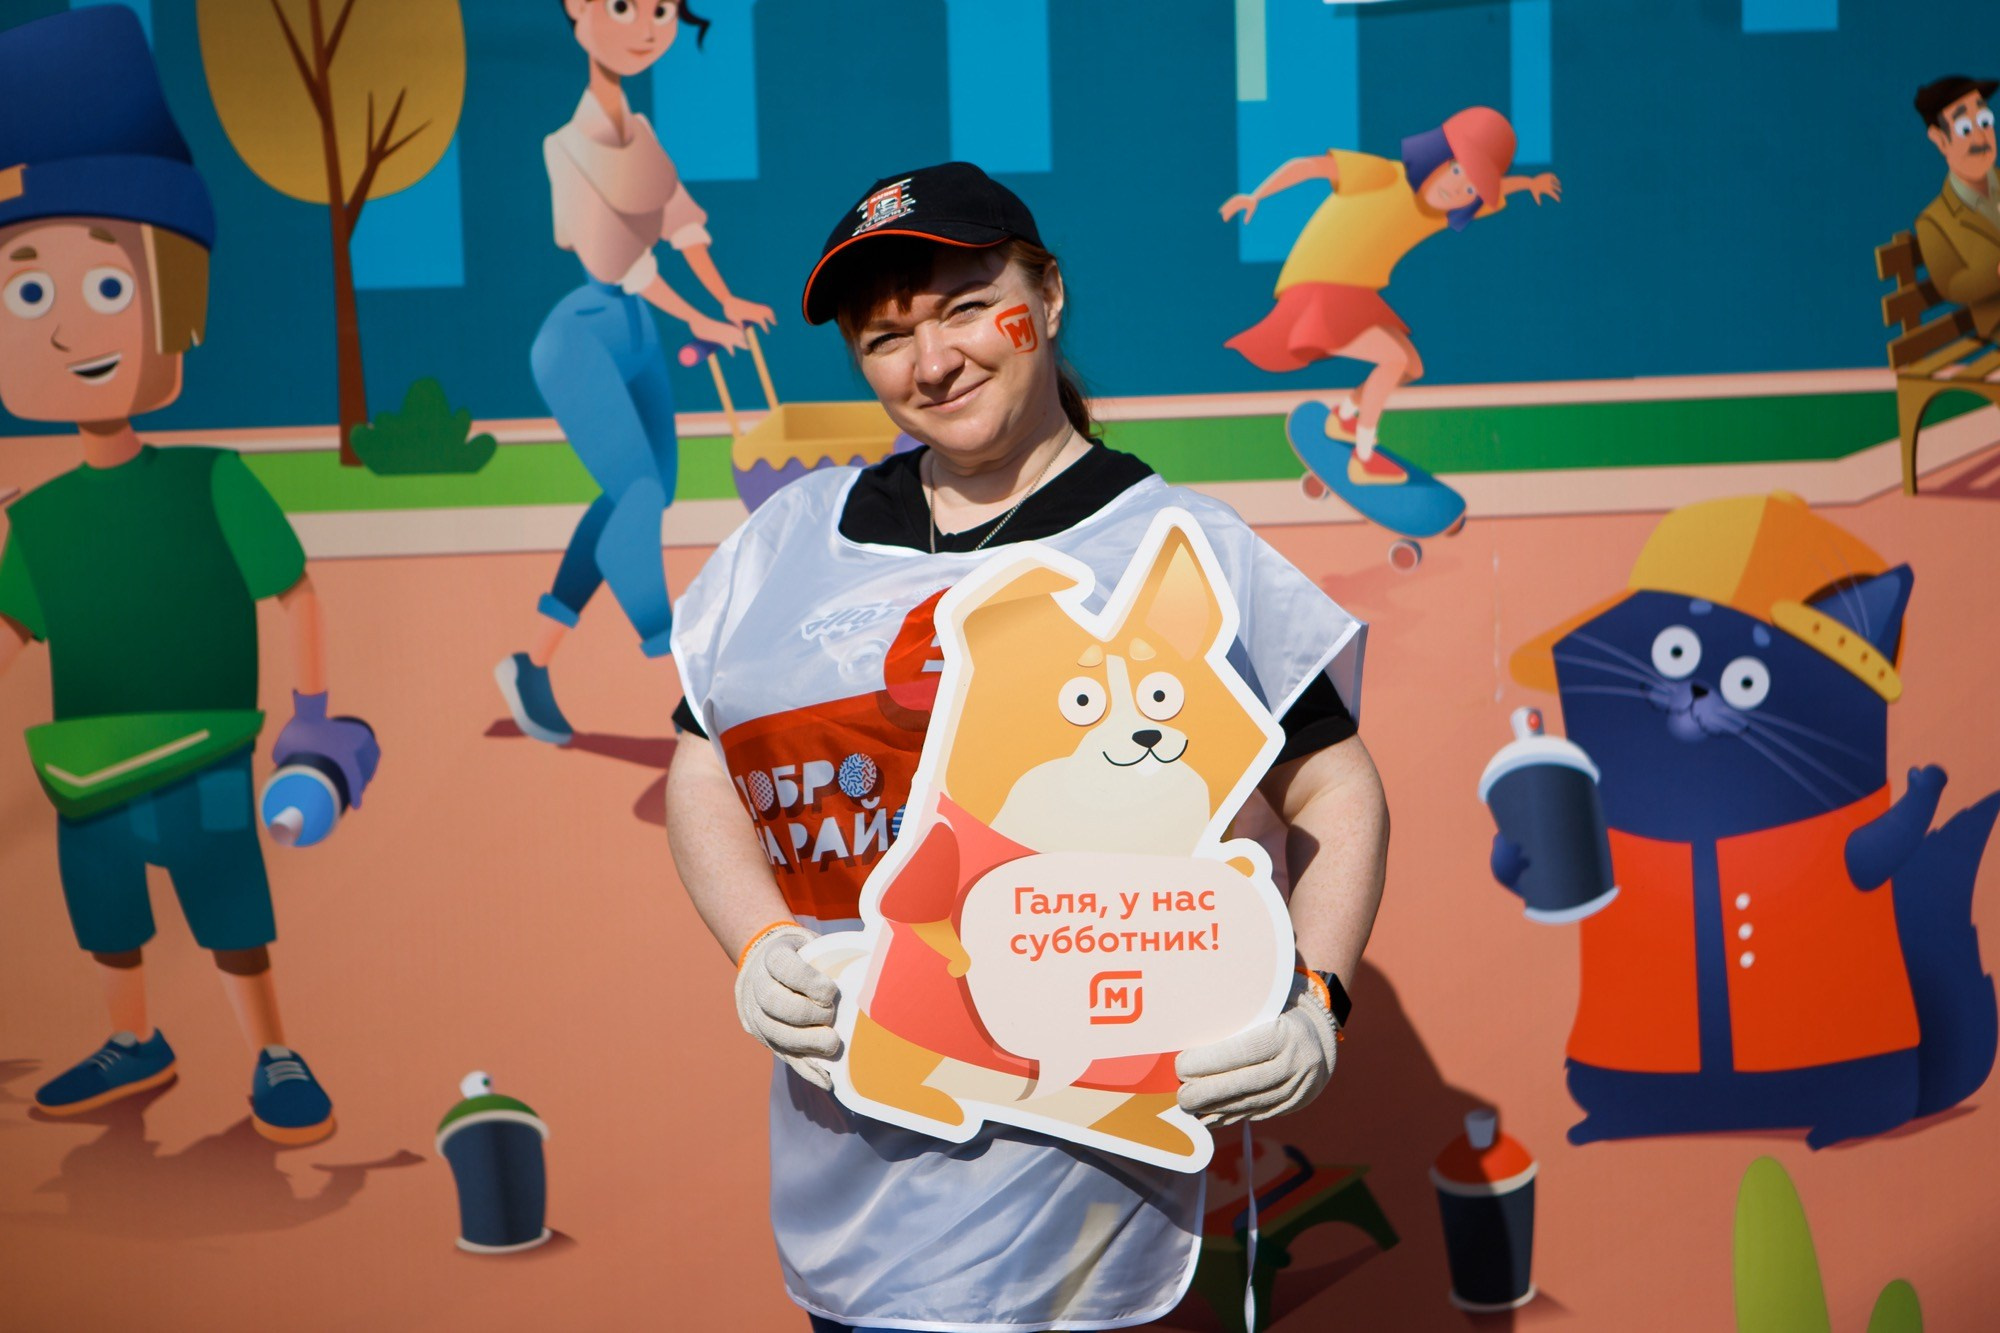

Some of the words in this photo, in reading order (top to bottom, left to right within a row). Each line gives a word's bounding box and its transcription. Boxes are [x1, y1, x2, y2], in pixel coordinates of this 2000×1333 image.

[1015, 887, 1108, 918] Галя,
[1119, 892, 1140, 920] у
[1152, 890, 1215, 912] нас
[1010, 923, 1219, 961] субботник!
